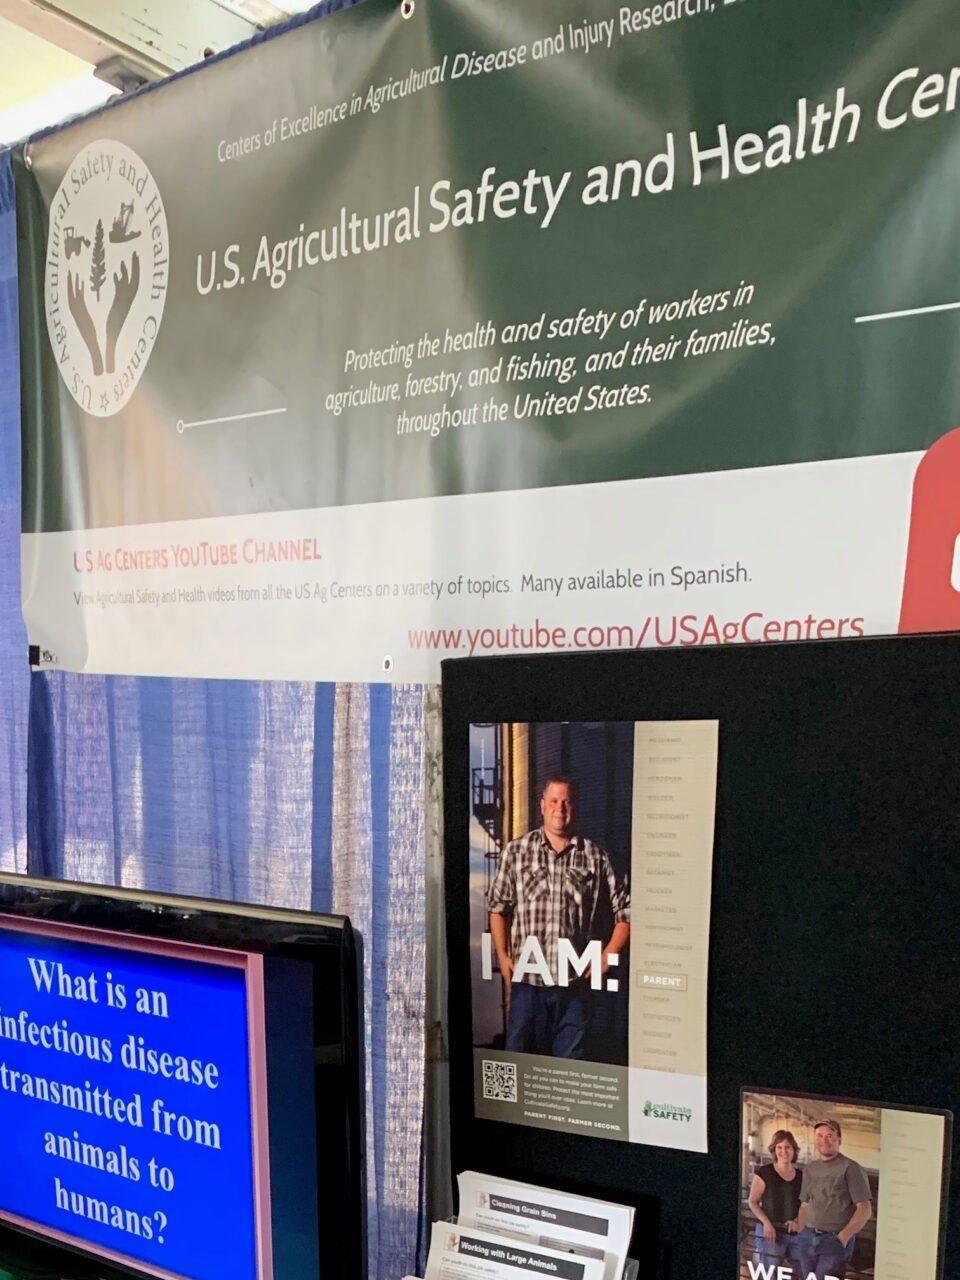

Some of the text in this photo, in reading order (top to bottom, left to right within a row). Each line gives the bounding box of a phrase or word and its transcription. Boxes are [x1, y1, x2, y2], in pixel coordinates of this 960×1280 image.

[218, 133, 261, 163] Centers
[264, 121, 279, 147] of
[281, 105, 346, 138] Excellence
[350, 94, 362, 115] in
[365, 54, 448, 112] Agricultural
[451, 43, 527, 82] Disease
[532, 25, 565, 61] and
[570, 17, 614, 53] Injury
[197, 244, 244, 296] U.S.
[253, 186, 419, 289] Agricultural
[429, 167, 571, 234] Safety
[581, 132, 675, 206] and
[690, 88, 862, 187] Health
[49, 150, 166, 411] U.S. Agricultural Safety and Health Centers
[345, 280, 755, 373] Protecting the health and safety of workers in
[325, 318, 777, 415] agriculture, forestry, and fishing, and their families,
[397, 382, 652, 436] throughout the United States.
[136, 587, 160, 606] Safety
[161, 587, 176, 603] and
[178, 586, 205, 602] Health
[207, 584, 236, 602] videos
[237, 583, 260, 601] from
[262, 583, 274, 600] all
[275, 583, 292, 600] the
[294, 582, 311, 600] US
[313, 583, 327, 603] Ag
[330, 580, 373, 598] Centers
[375, 583, 391, 597] on
[392, 584, 399, 597] a
[402, 577, 443, 600] variety
[447, 575, 463, 595] of
[521, 572, 563, 596] Many
[567, 567, 642, 592] available
[648, 567, 665, 587] in
[670, 562, 752, 591] Spanish.
[27, 957, 170, 1018] What is an
[481, 933, 619, 993] I AM:
[643, 975, 682, 987] PARENT
[120, 1036, 220, 1090] disease
[0, 1062, 222, 1150] transmitted from
[653, 1110, 692, 1122] SAFETY
[44, 1129, 175, 1192] animals to
[54, 1177, 168, 1245] humans?
[491, 1199, 557, 1220] Cleaning Grain Bins
[461, 1240, 558, 1272] Working with Large Animals
